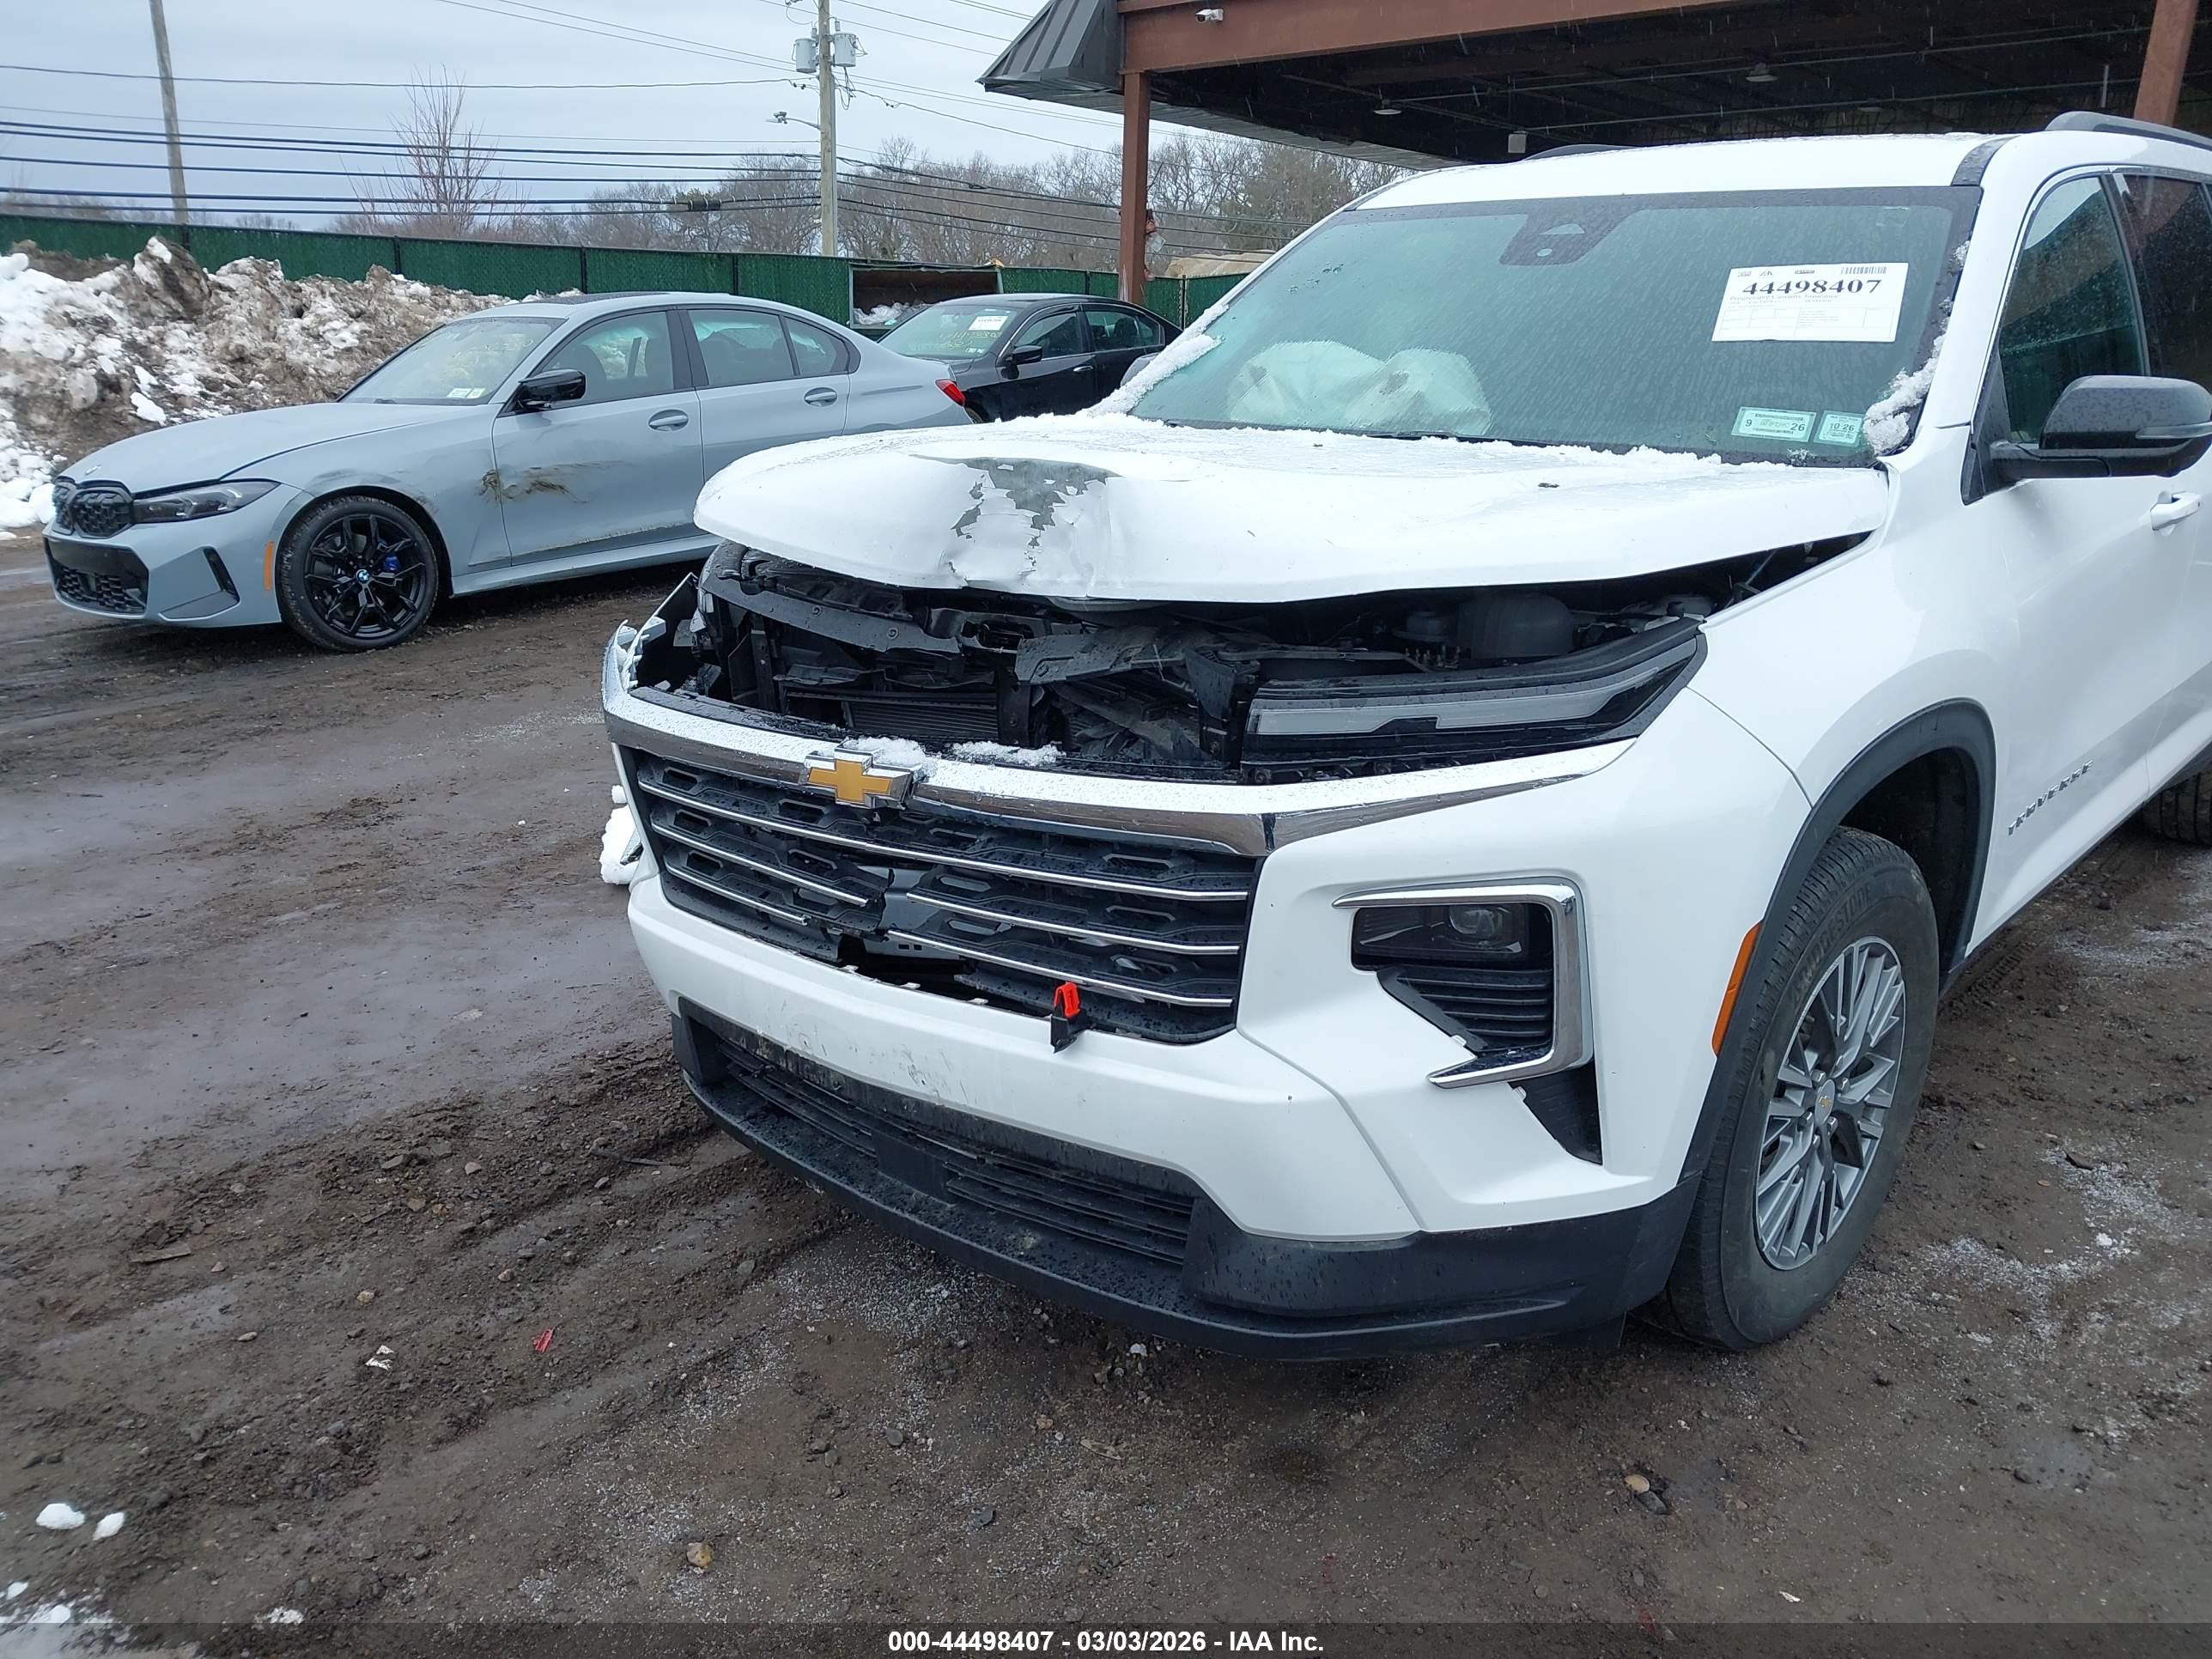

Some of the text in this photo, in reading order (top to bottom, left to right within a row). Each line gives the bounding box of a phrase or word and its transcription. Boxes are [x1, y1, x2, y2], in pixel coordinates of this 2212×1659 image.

[1742, 278, 1883, 295] 44498407
[1745, 419, 1753, 428] 9
[1790, 422, 1806, 432] 26
[2008, 759, 2094, 836] TRAVERSE
